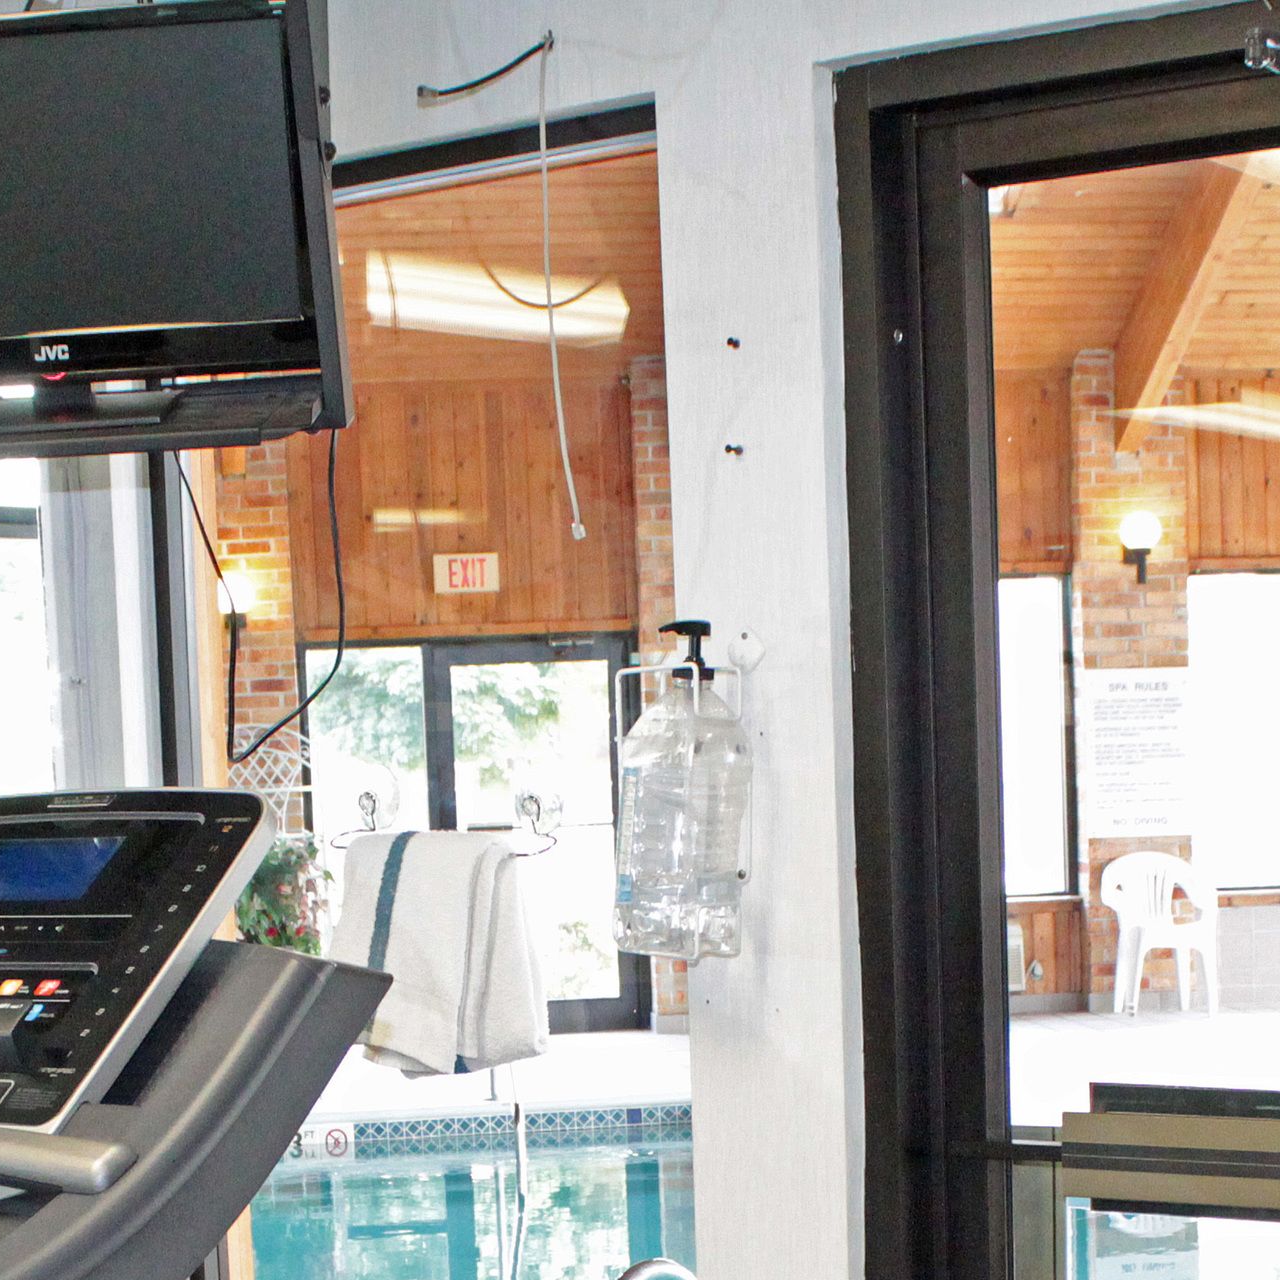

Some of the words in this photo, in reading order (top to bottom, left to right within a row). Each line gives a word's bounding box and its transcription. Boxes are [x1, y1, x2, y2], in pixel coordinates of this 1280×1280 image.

[34, 344, 70, 362] JVC
[448, 557, 487, 588] EXIT
[1108, 683, 1128, 693] SPA
[1134, 681, 1169, 692] RULES
[1112, 818, 1127, 826] NO
[1134, 816, 1169, 825] DIVING
